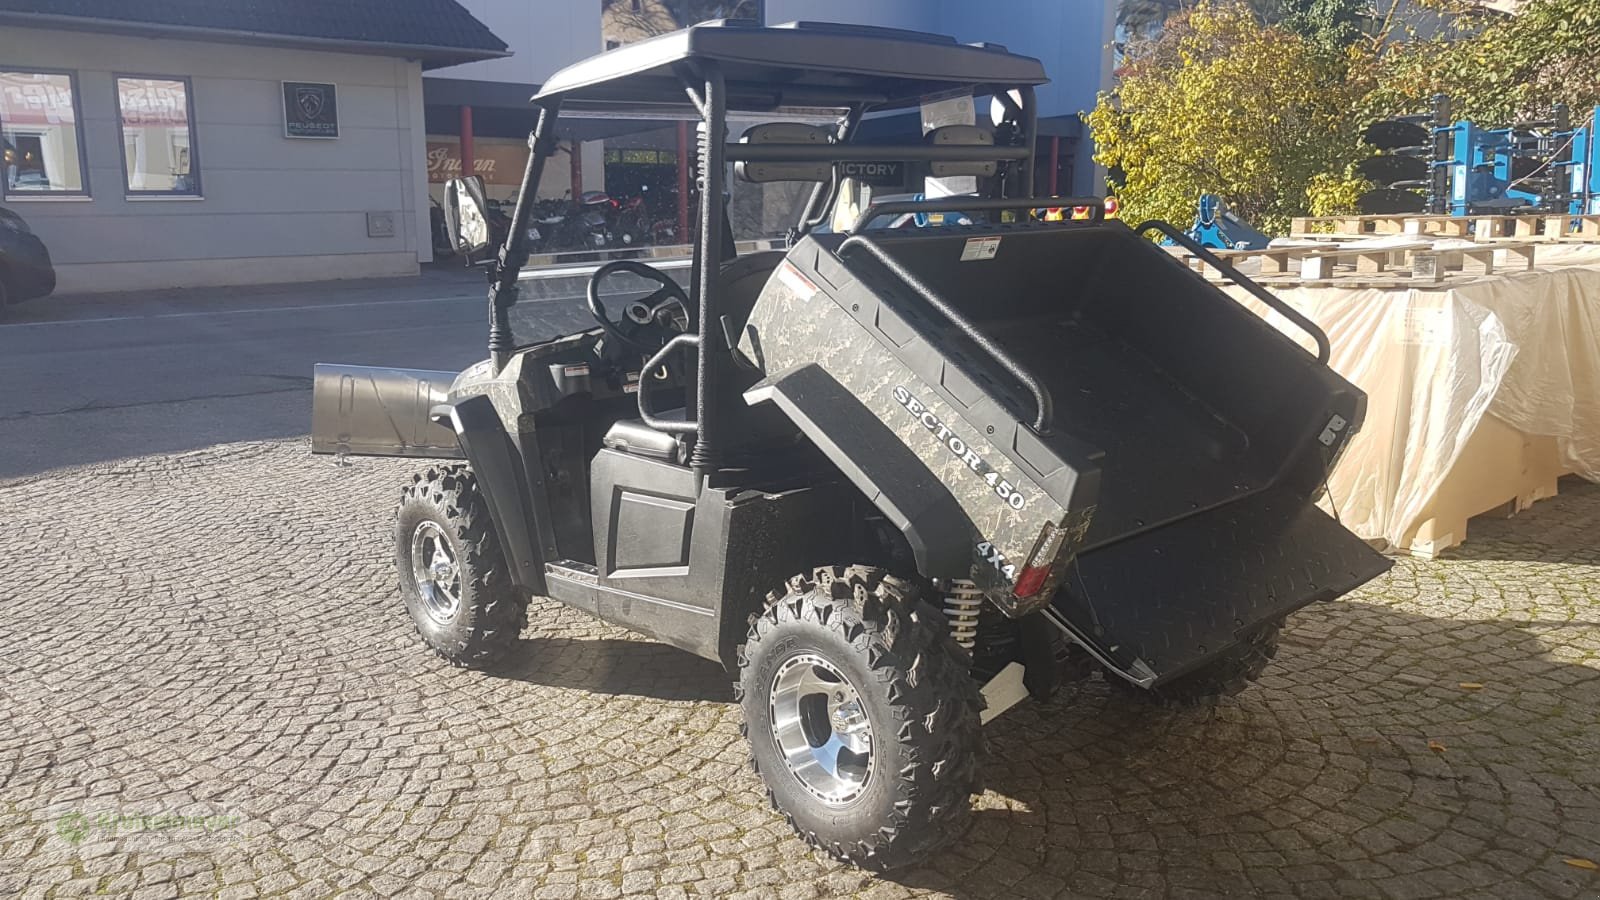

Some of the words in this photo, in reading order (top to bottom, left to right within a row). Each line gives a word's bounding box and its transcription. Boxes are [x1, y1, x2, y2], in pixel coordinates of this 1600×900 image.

[841, 163, 897, 175] ICTORY
[892, 385, 982, 471] SECTOR
[983, 470, 1026, 511] 450
